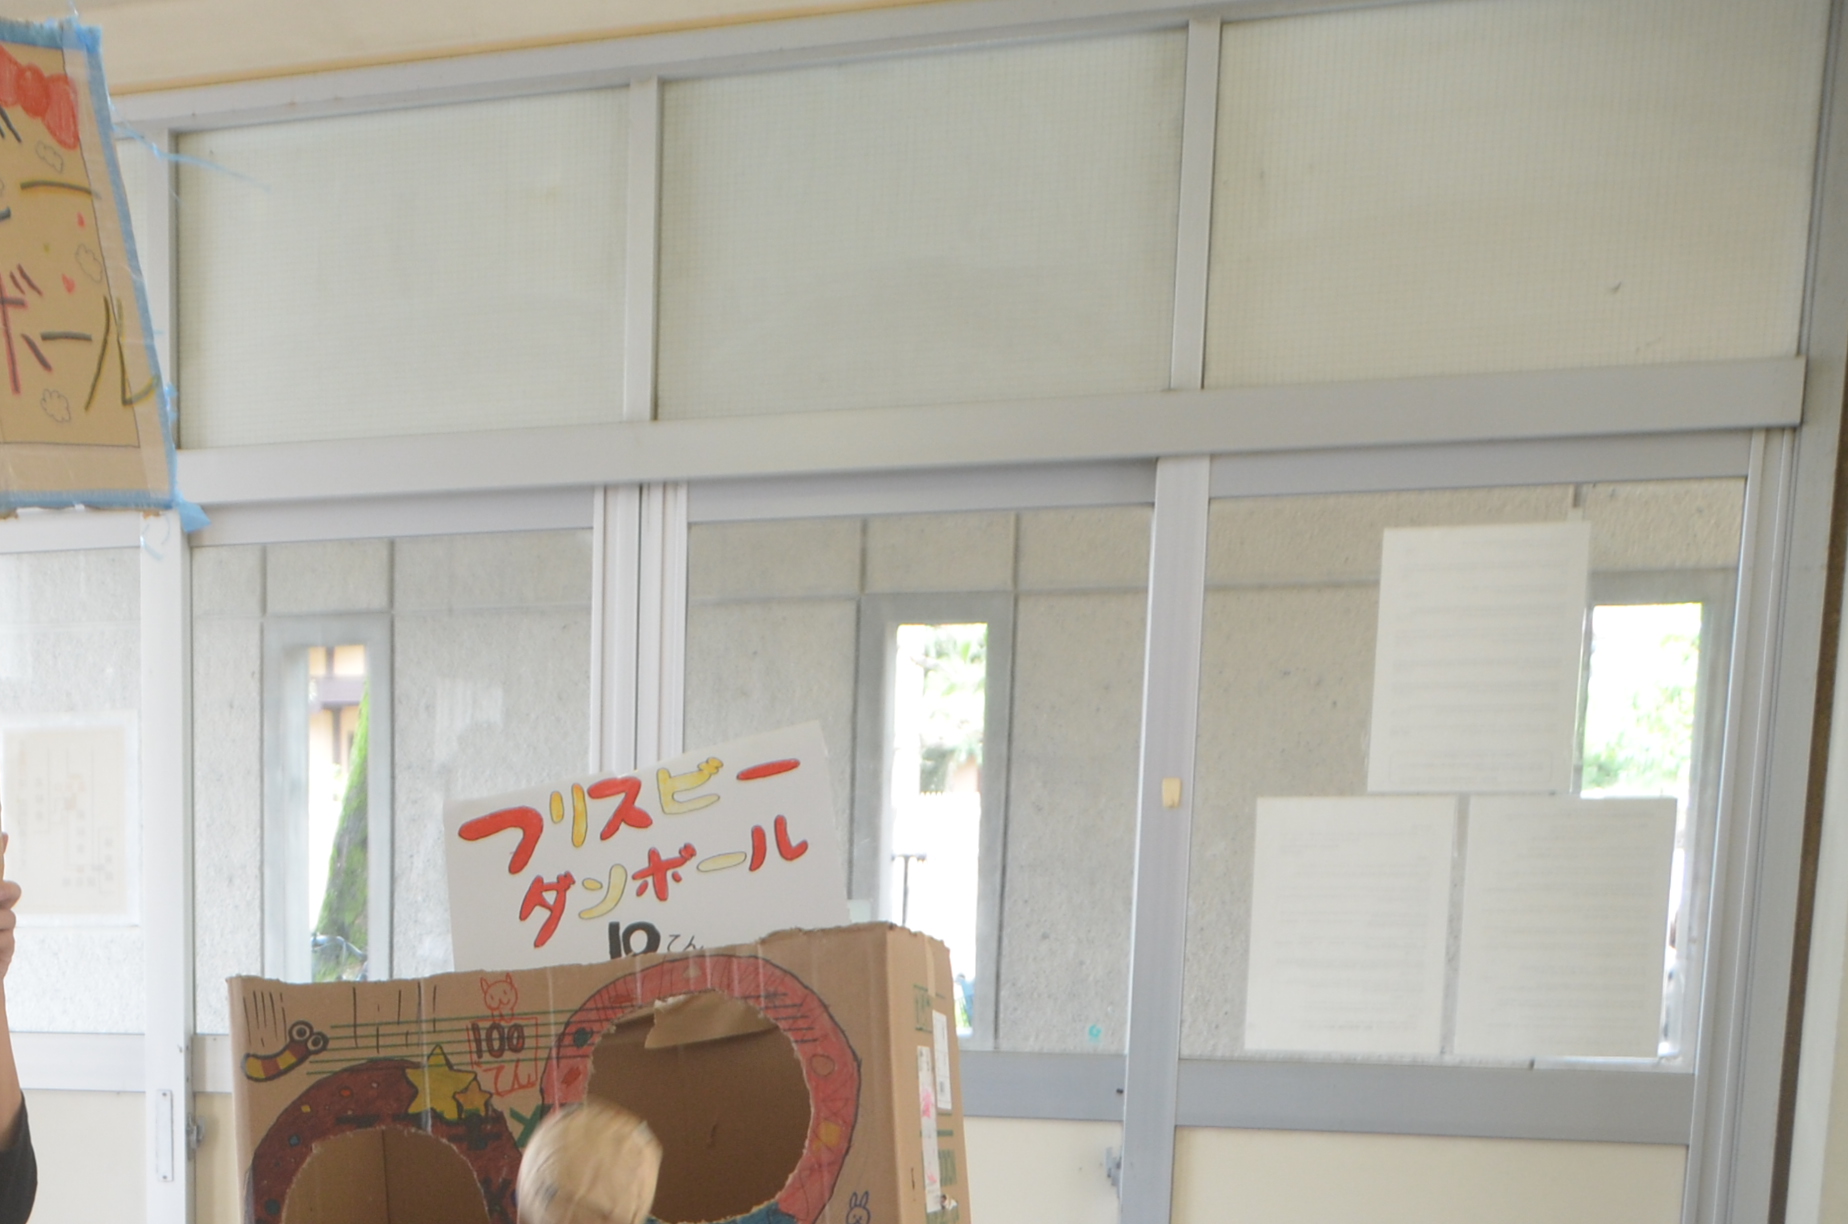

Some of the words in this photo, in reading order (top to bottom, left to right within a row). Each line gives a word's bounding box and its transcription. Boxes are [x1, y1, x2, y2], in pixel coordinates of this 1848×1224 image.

[458, 757, 800, 874] フリスビー
[519, 815, 809, 948] ダンボール
[471, 1022, 525, 1060] 100
